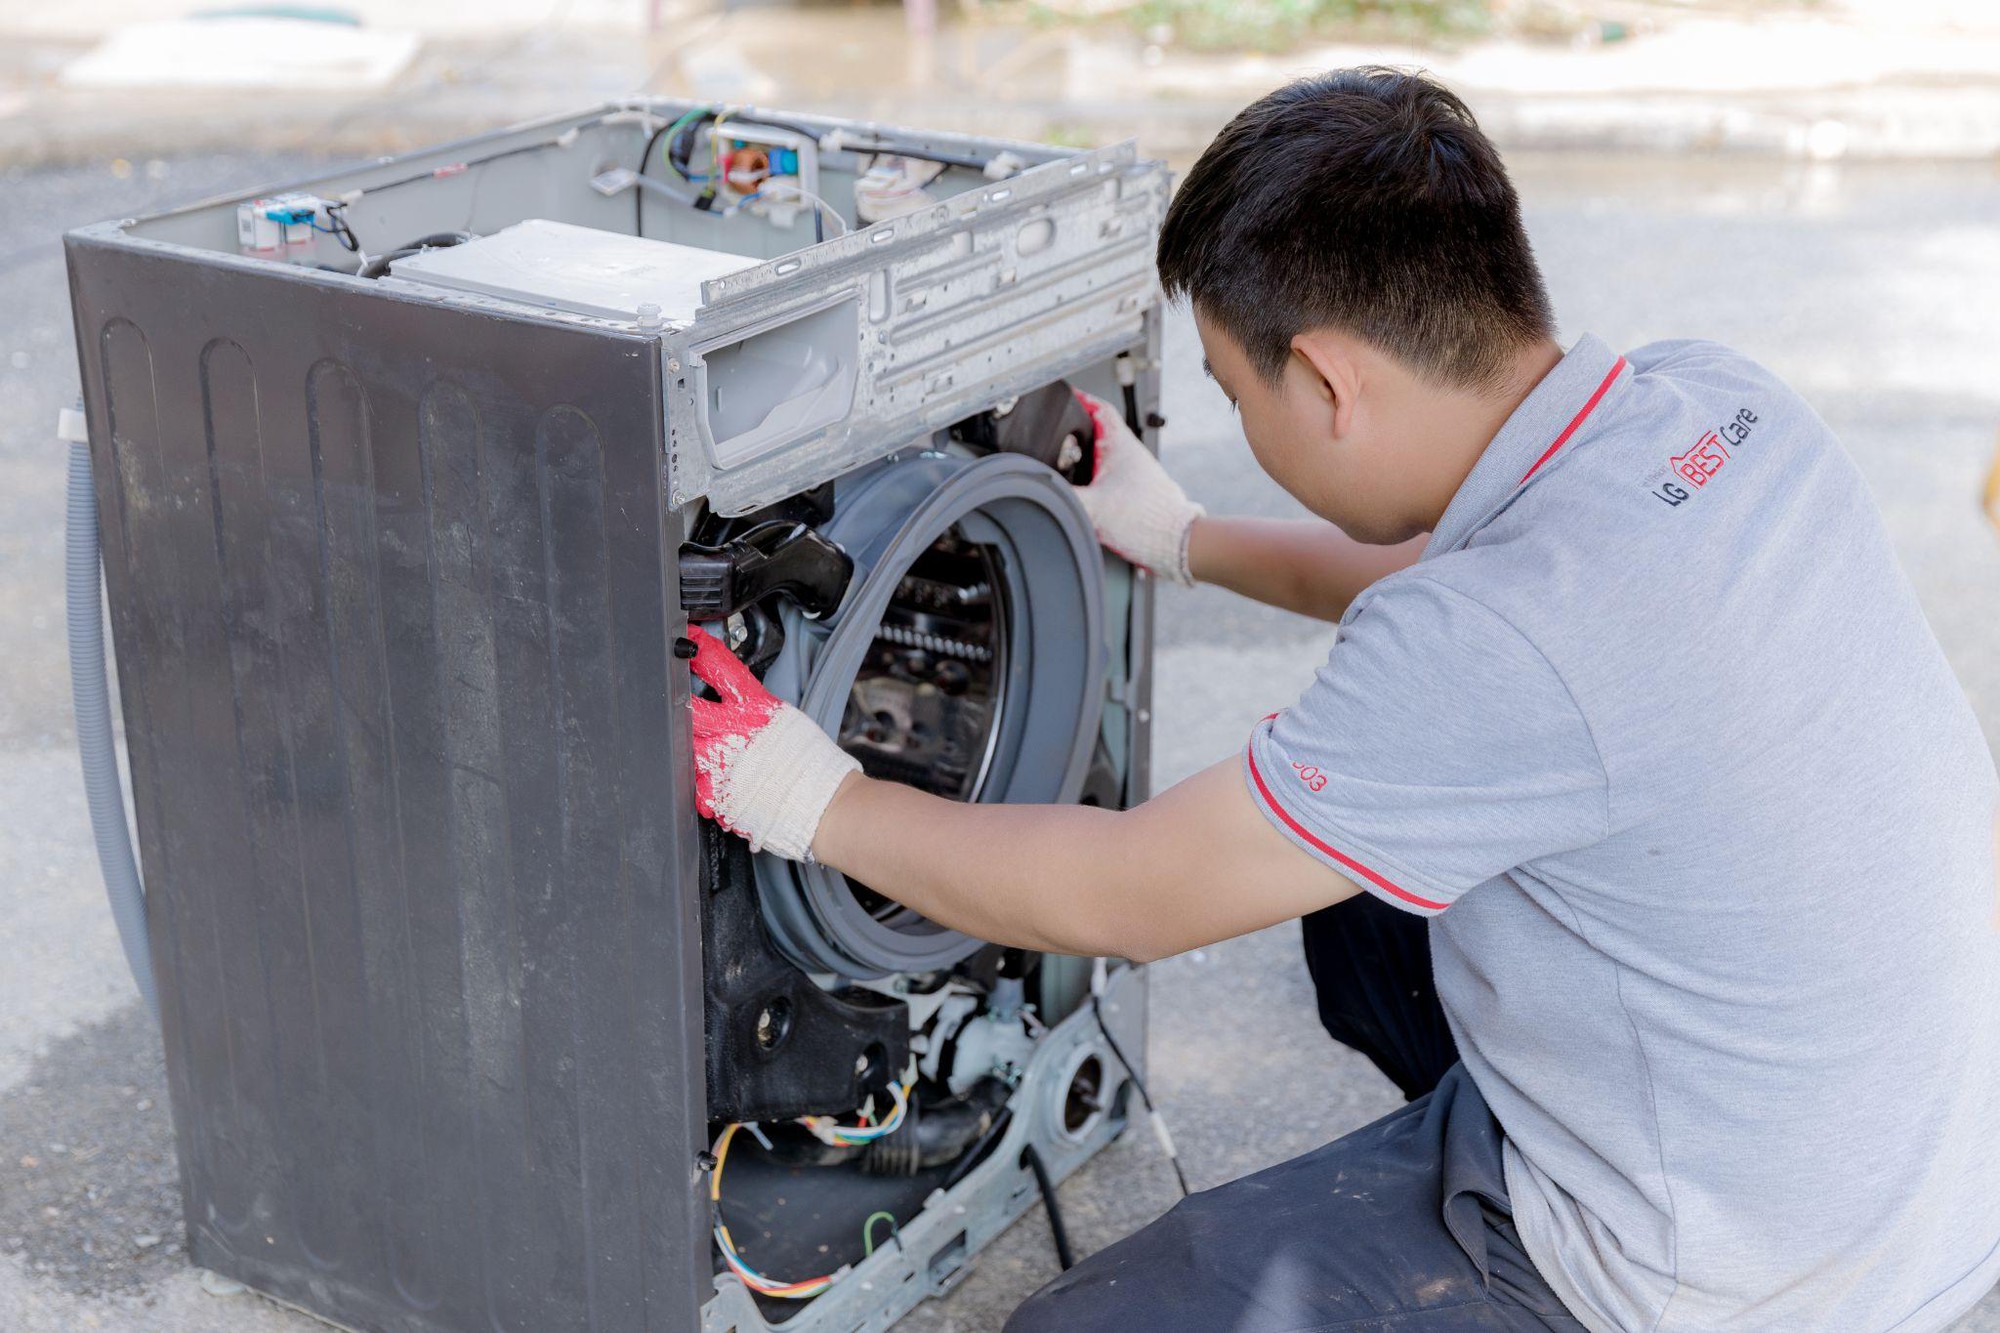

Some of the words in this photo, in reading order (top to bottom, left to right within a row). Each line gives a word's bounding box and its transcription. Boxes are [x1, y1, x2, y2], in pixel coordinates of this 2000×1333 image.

[1652, 482, 1690, 507] LG
[1680, 434, 1731, 486] BEST
[1719, 408, 1759, 446] Care
